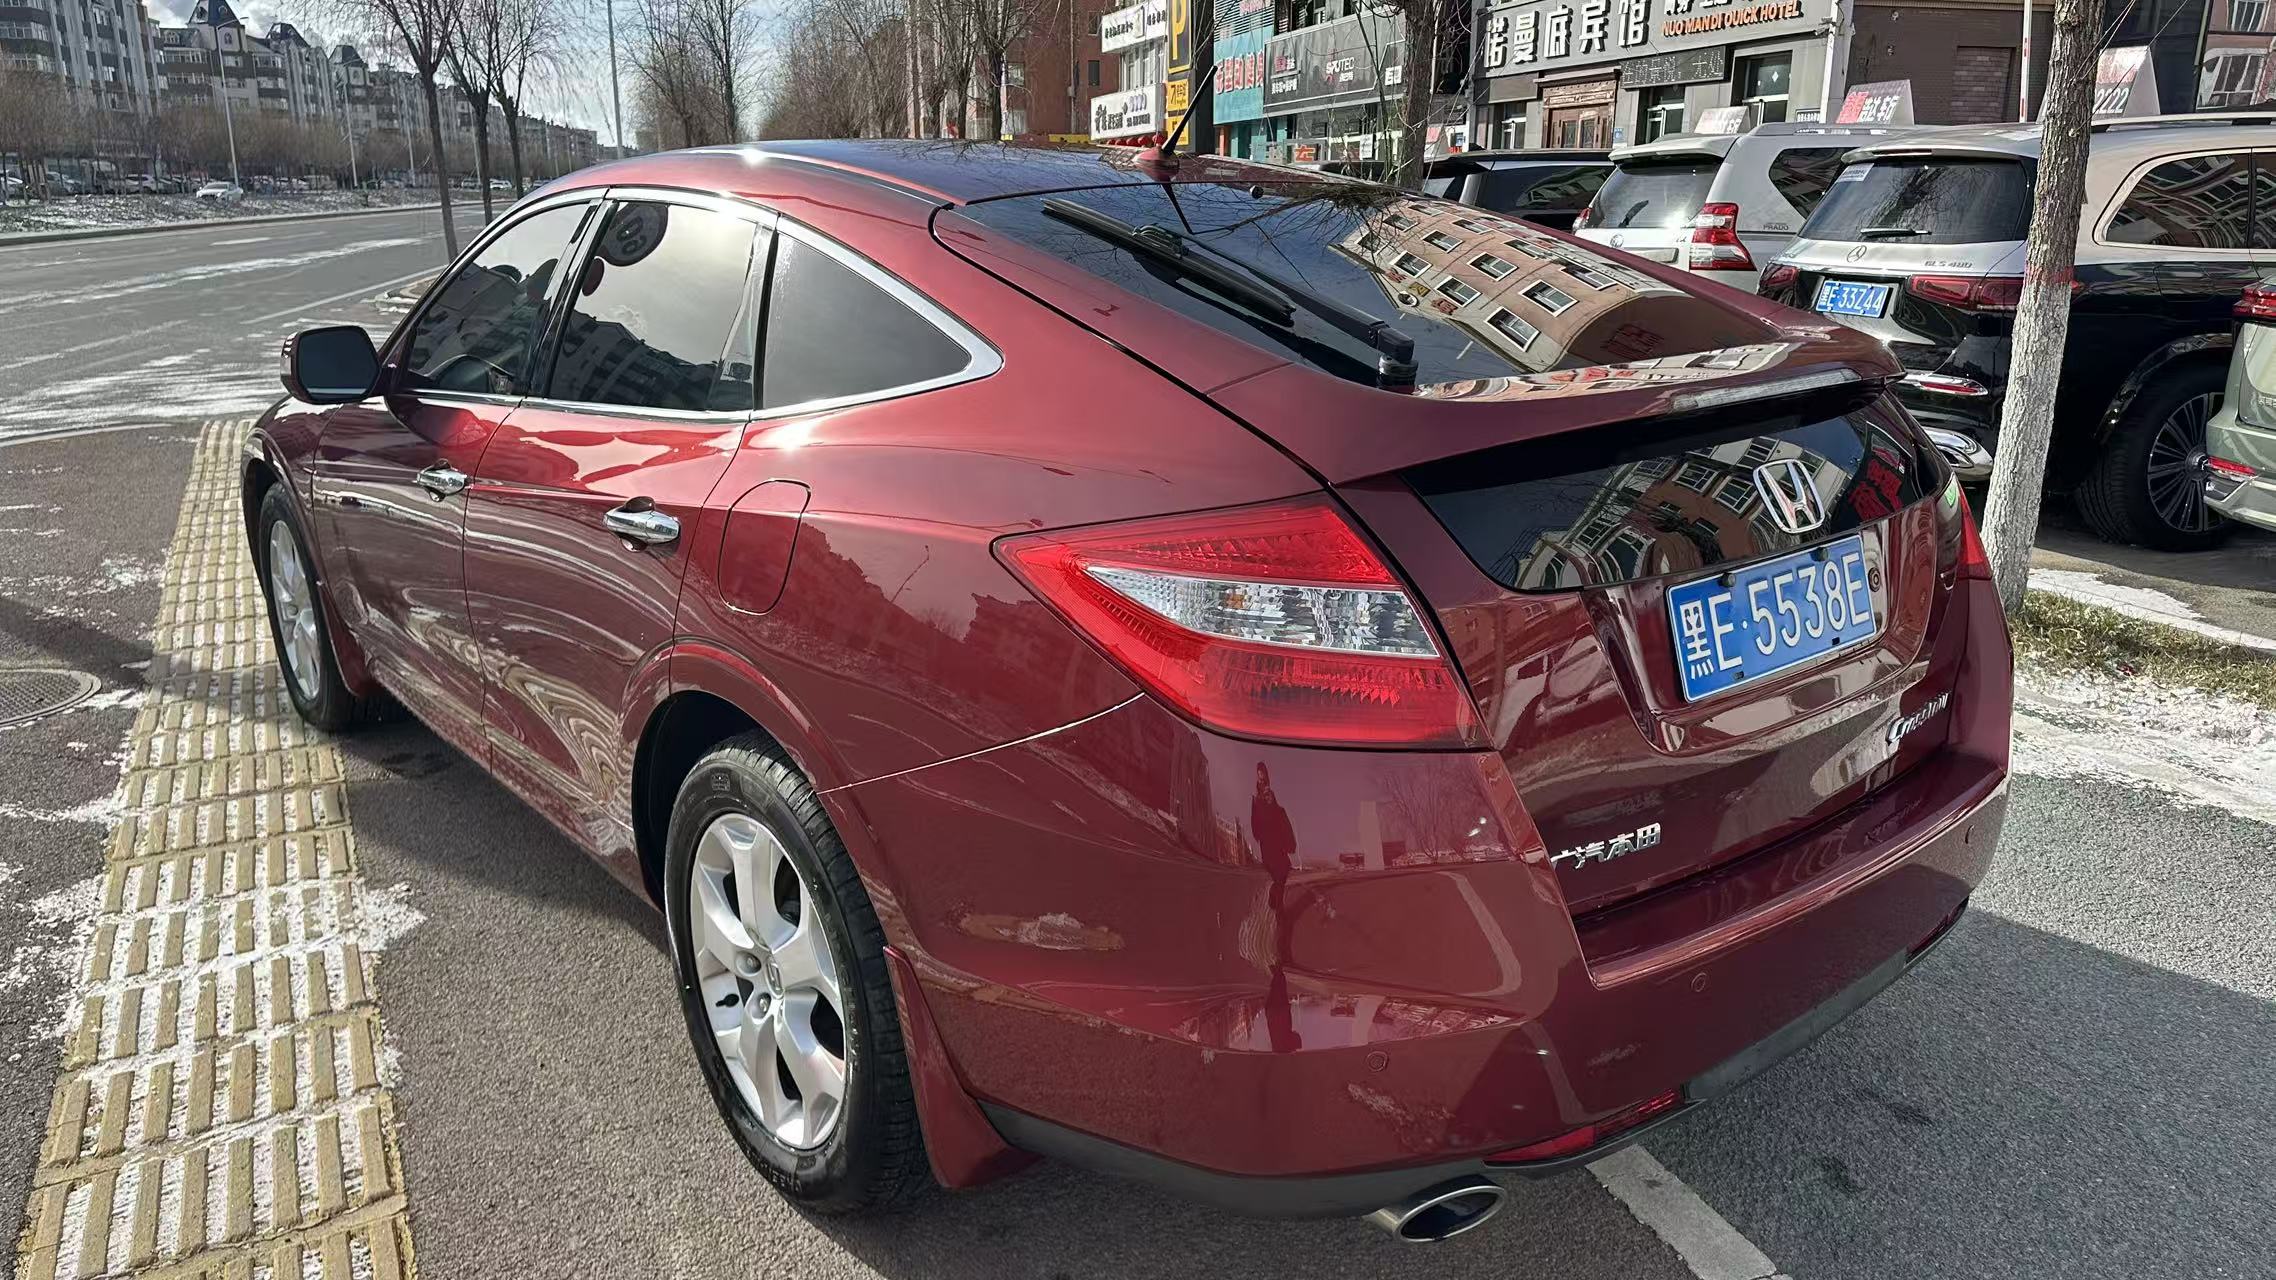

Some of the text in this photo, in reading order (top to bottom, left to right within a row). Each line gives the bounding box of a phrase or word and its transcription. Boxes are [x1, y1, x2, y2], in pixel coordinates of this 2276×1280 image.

[1484, 0, 1646, 68] 诺曼底宾馆
[1664, 20, 1684, 36] NUO
[1760, 0, 1799, 21] HOTEL
[1763, 223, 1789, 231] PRADO
[1924, 260, 1946, 268] GLS
[1679, 552, 1871, 681] 黑E·5538E
[1550, 822, 1661, 870] 广汽本田
